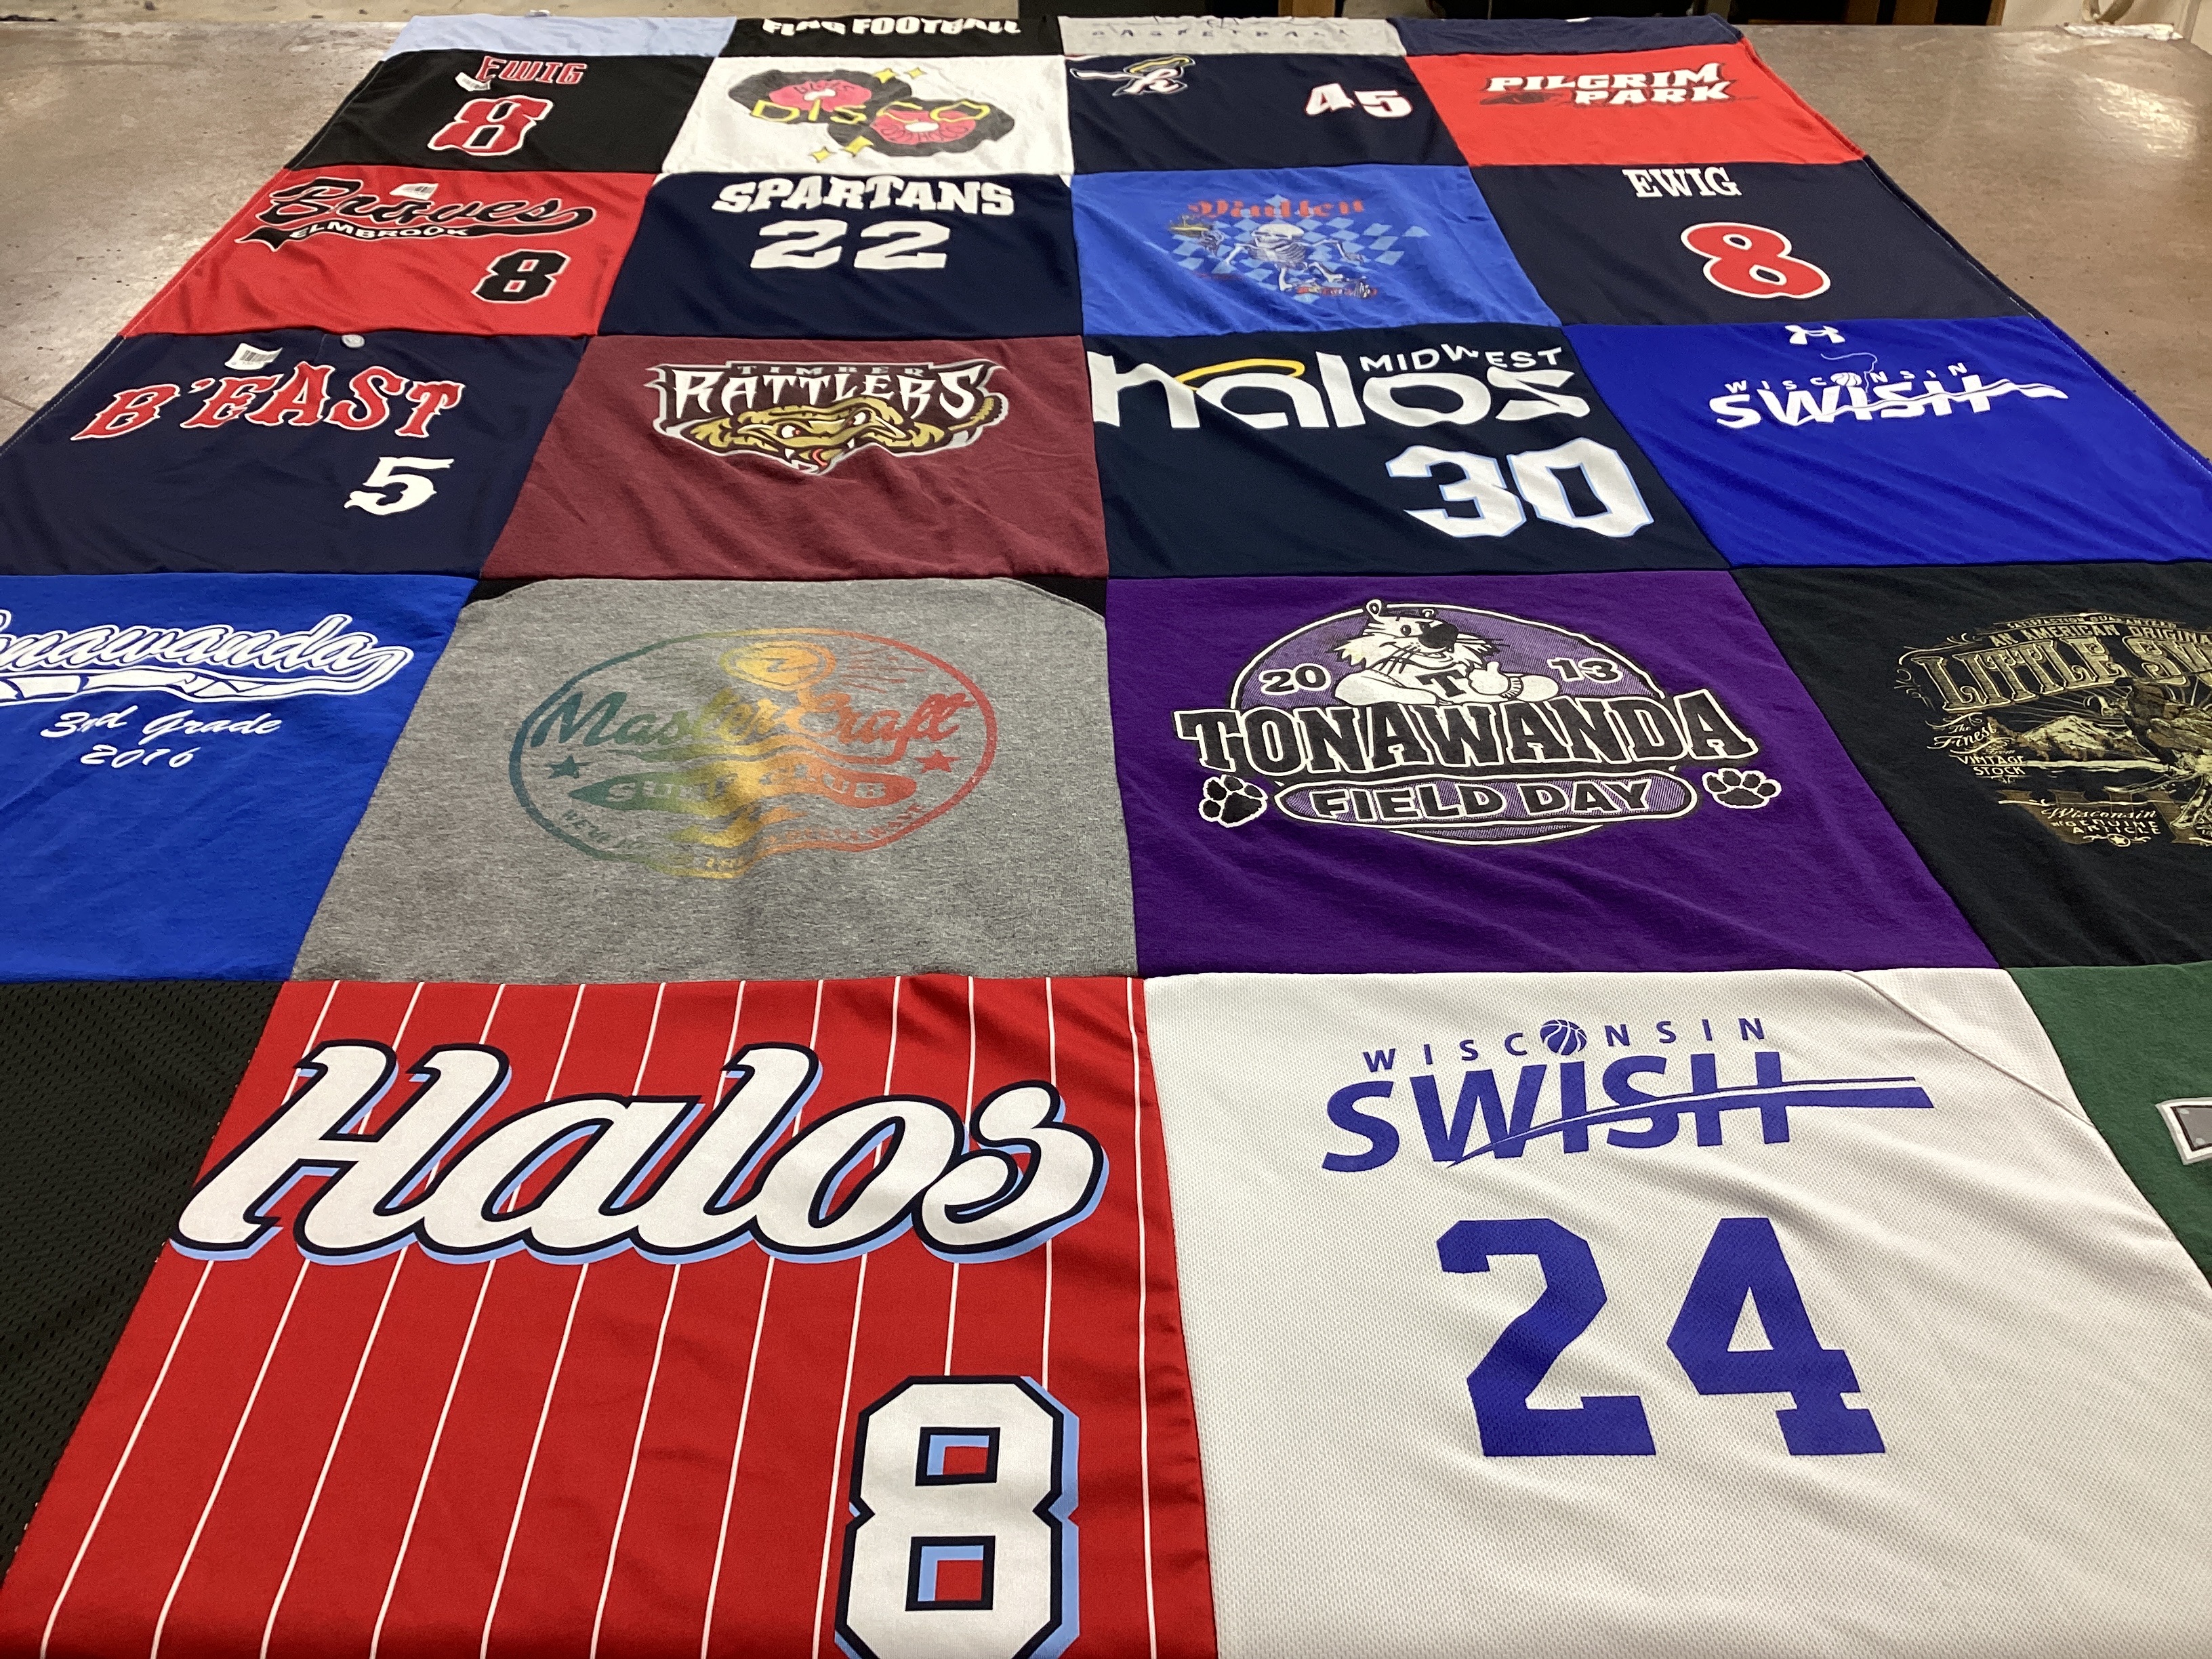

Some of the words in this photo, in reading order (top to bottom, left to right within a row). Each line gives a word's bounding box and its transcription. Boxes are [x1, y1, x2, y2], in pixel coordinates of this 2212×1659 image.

[762, 18, 846, 37] FLAG
[851, 16, 1021, 36] FOOTBALL
[475, 55, 588, 85] EWIG
[1485, 62, 1724, 92] PILGRIM
[750, 100, 991, 124] DISCO
[1303, 82, 1414, 119] 45
[1572, 80, 1732, 106] PARK
[427, 94, 554, 157] 8
[711, 175, 1015, 216] SPARTANS
[1622, 167, 1742, 199] EWIG
[255, 176, 596, 232] Braves
[289, 220, 470, 239] ELMBROOK
[749, 218, 951, 270] 22
[471, 248, 571, 304] 8
[1681, 222, 1831, 299] 8
[737, 365, 925, 377] TIMBER
[1359, 344, 1563, 372] MIDWEST
[1723, 361, 1969, 394] WISCONSIN
[70, 361, 466, 441] B'EAST
[671, 363, 986, 420] RATTLERS
[1086, 350, 1591, 429] halos
[1708, 374, 1995, 430] SWISH
[344, 456, 455, 516] 5
[1385, 436, 1655, 538] 30
[0, 609, 413, 672] nawanda
[1989, 632, 2019, 648] AN
[2023, 623, 2121, 641] AMERICAN
[2006, 615, 2086, 629] SATISFACTION
[1258, 662, 1332, 695] 20
[1545, 655, 1624, 684] 13
[1414, 669, 1467, 698] T
[1910, 636, 2132, 713] LITTLE
[40, 704, 139, 738] 3rd
[138, 709, 283, 745] Grade
[1174, 687, 1760, 777] TONAWANDA
[1927, 722, 1997, 750] Finest
[1948, 723, 1972, 734] The
[79, 743, 202, 769] 2016
[1972, 766, 2026, 776] STOCK
[1308, 779, 1511, 823] FIELD
[1517, 777, 1656, 816] DAY
[2041, 806, 2158, 819] Wisconsin
[2065, 819, 2159, 827] GENUINE
[2072, 825, 2162, 835] ARTICLE
[1361, 1017, 1765, 1073] WISCONSIN
[1321, 1050, 1790, 1173] SWISH
[169, 1038, 1110, 1265] Halos
[1435, 1216, 1886, 1457] 24
[834, 1373, 1081, 1659] 8
